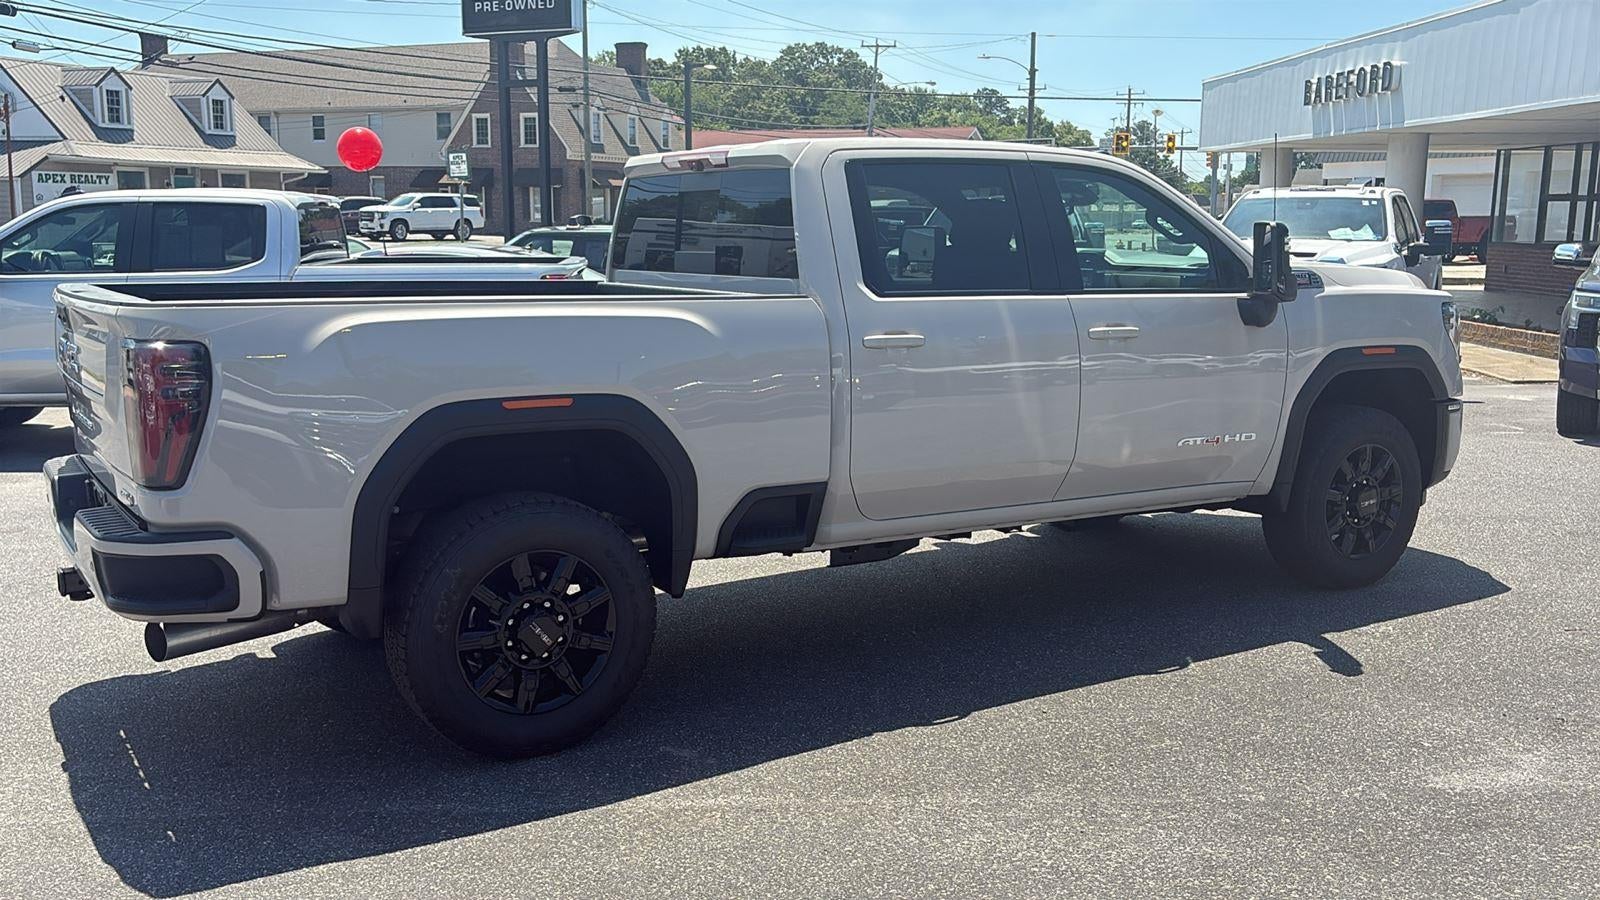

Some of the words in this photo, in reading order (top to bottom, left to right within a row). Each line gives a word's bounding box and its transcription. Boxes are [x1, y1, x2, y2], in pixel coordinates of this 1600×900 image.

[474, 0, 555, 12] PRE-OWNED
[1303, 61, 1393, 106] BAREFORD
[37, 172, 67, 184] APEX
[69, 174, 110, 185] REALTY
[1177, 435, 1221, 447] AT4
[1224, 432, 1256, 443] HD
